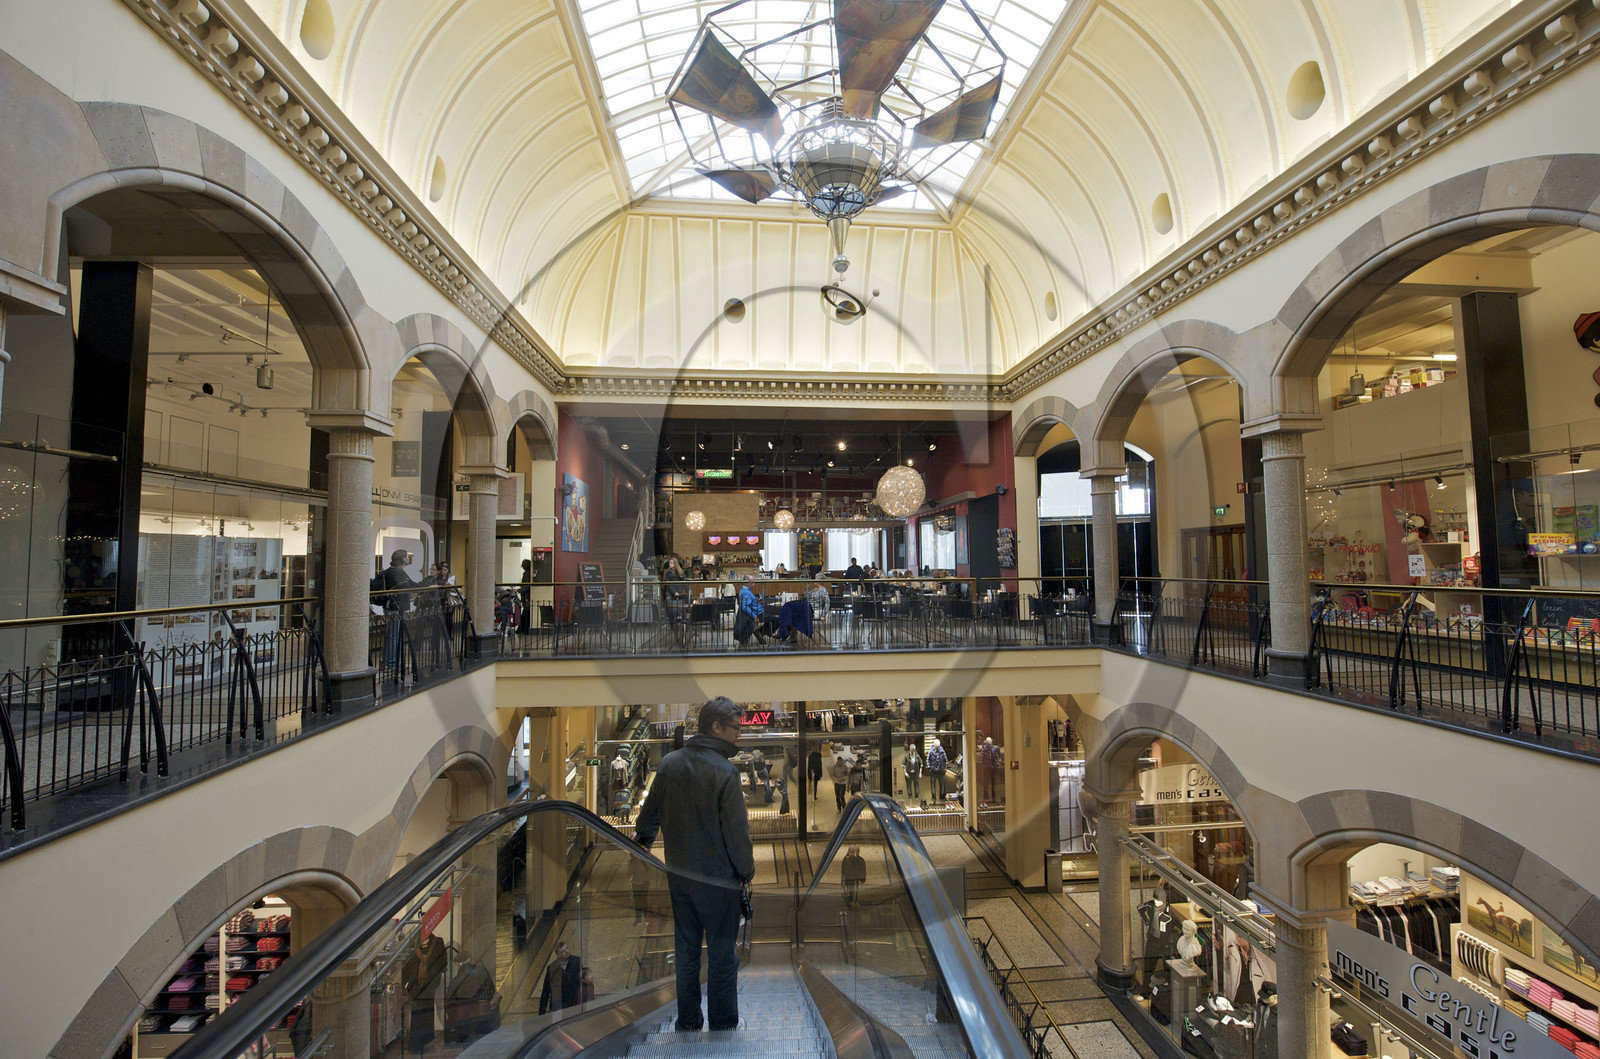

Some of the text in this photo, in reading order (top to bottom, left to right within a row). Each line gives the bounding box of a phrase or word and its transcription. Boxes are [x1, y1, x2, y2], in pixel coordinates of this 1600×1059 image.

[740, 711, 772, 726] LAY
[1188, 768, 1219, 786] Gen
[1157, 789, 1222, 800] men's cas
[1335, 949, 1390, 999] men's
[1409, 963, 1517, 1052] Gentle
